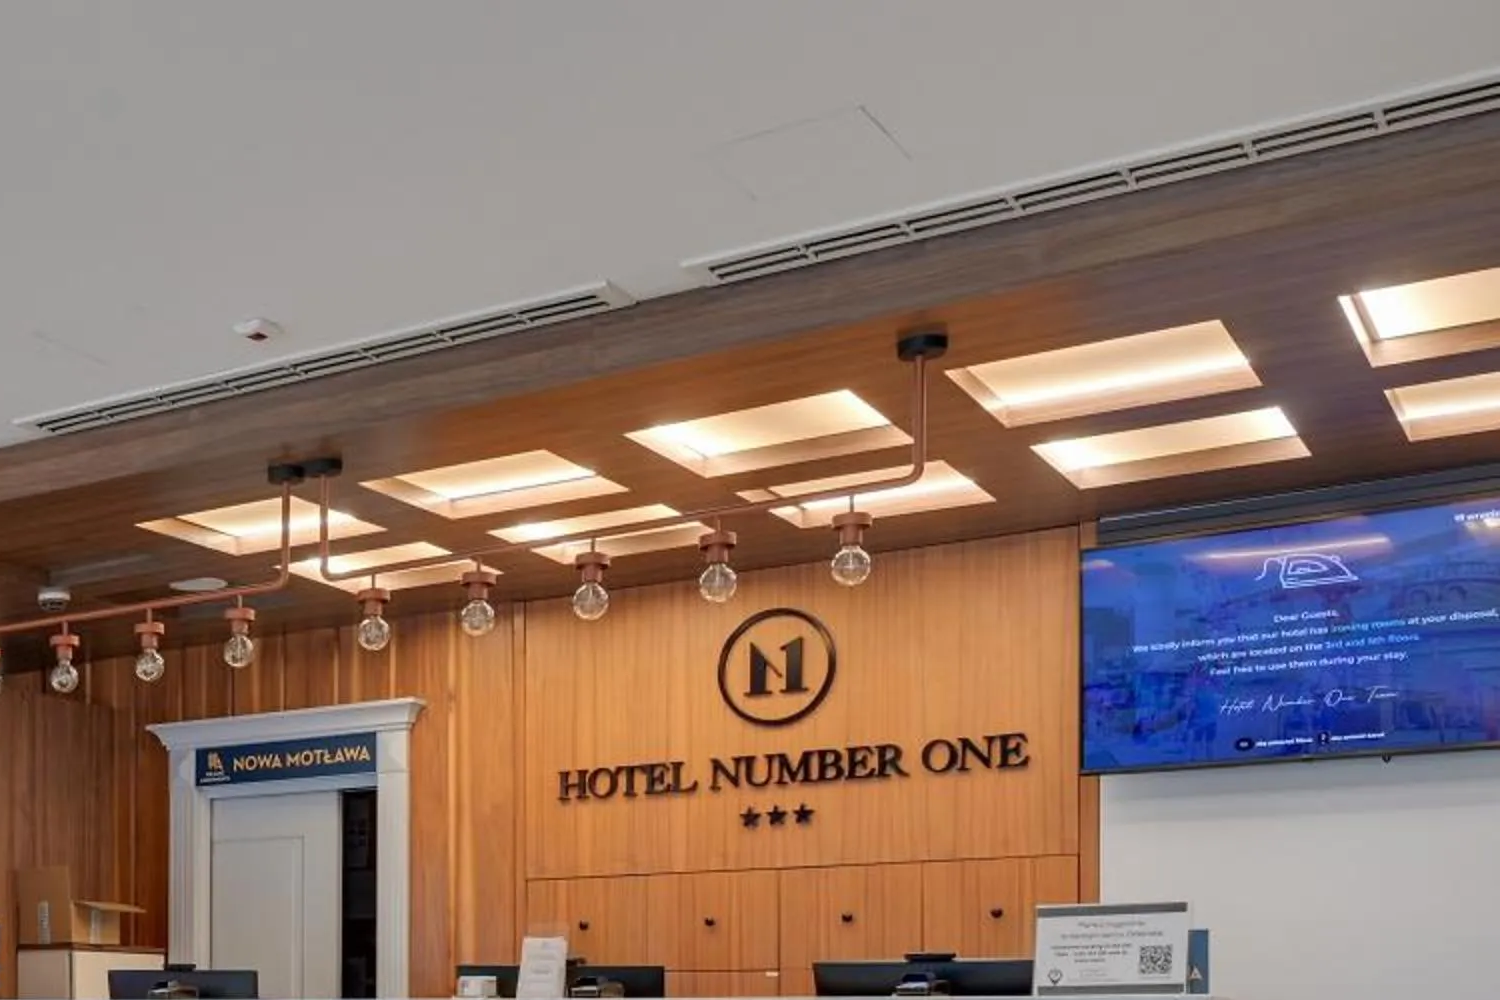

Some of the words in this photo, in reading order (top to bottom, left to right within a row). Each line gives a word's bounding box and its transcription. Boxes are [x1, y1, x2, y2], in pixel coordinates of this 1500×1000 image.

[1182, 638, 1215, 648] inform
[1217, 637, 1236, 647] you
[1238, 633, 1258, 642] that
[1281, 627, 1308, 638] hotel
[1309, 626, 1328, 635] has
[1330, 621, 1369, 634] ironing
[1408, 616, 1420, 625] at
[1421, 613, 1447, 625] your
[1449, 607, 1500, 621] disposal,
[1274, 612, 1299, 623] Dear
[1198, 651, 1229, 662] which
[1231, 649, 1247, 659] are
[1249, 646, 1287, 657] located
[1290, 645, 1303, 653] on
[1305, 642, 1322, 651] the
[1345, 637, 1365, 647] and
[1210, 666, 1230, 676] Feel
[1233, 663, 1252, 674] free
[1255, 663, 1266, 672] to
[1267, 662, 1287, 671] use
[1289, 660, 1317, 669] them
[1319, 655, 1355, 666] during
[1356, 653, 1381, 664] your
[1384, 650, 1409, 661] stay.
[233, 753, 283, 772] NOWA
[286, 745, 371, 768] MOTŁAWA
[557, 761, 698, 804] HOTEL
[709, 743, 909, 793] NUMBER
[921, 733, 1031, 774] ONE
